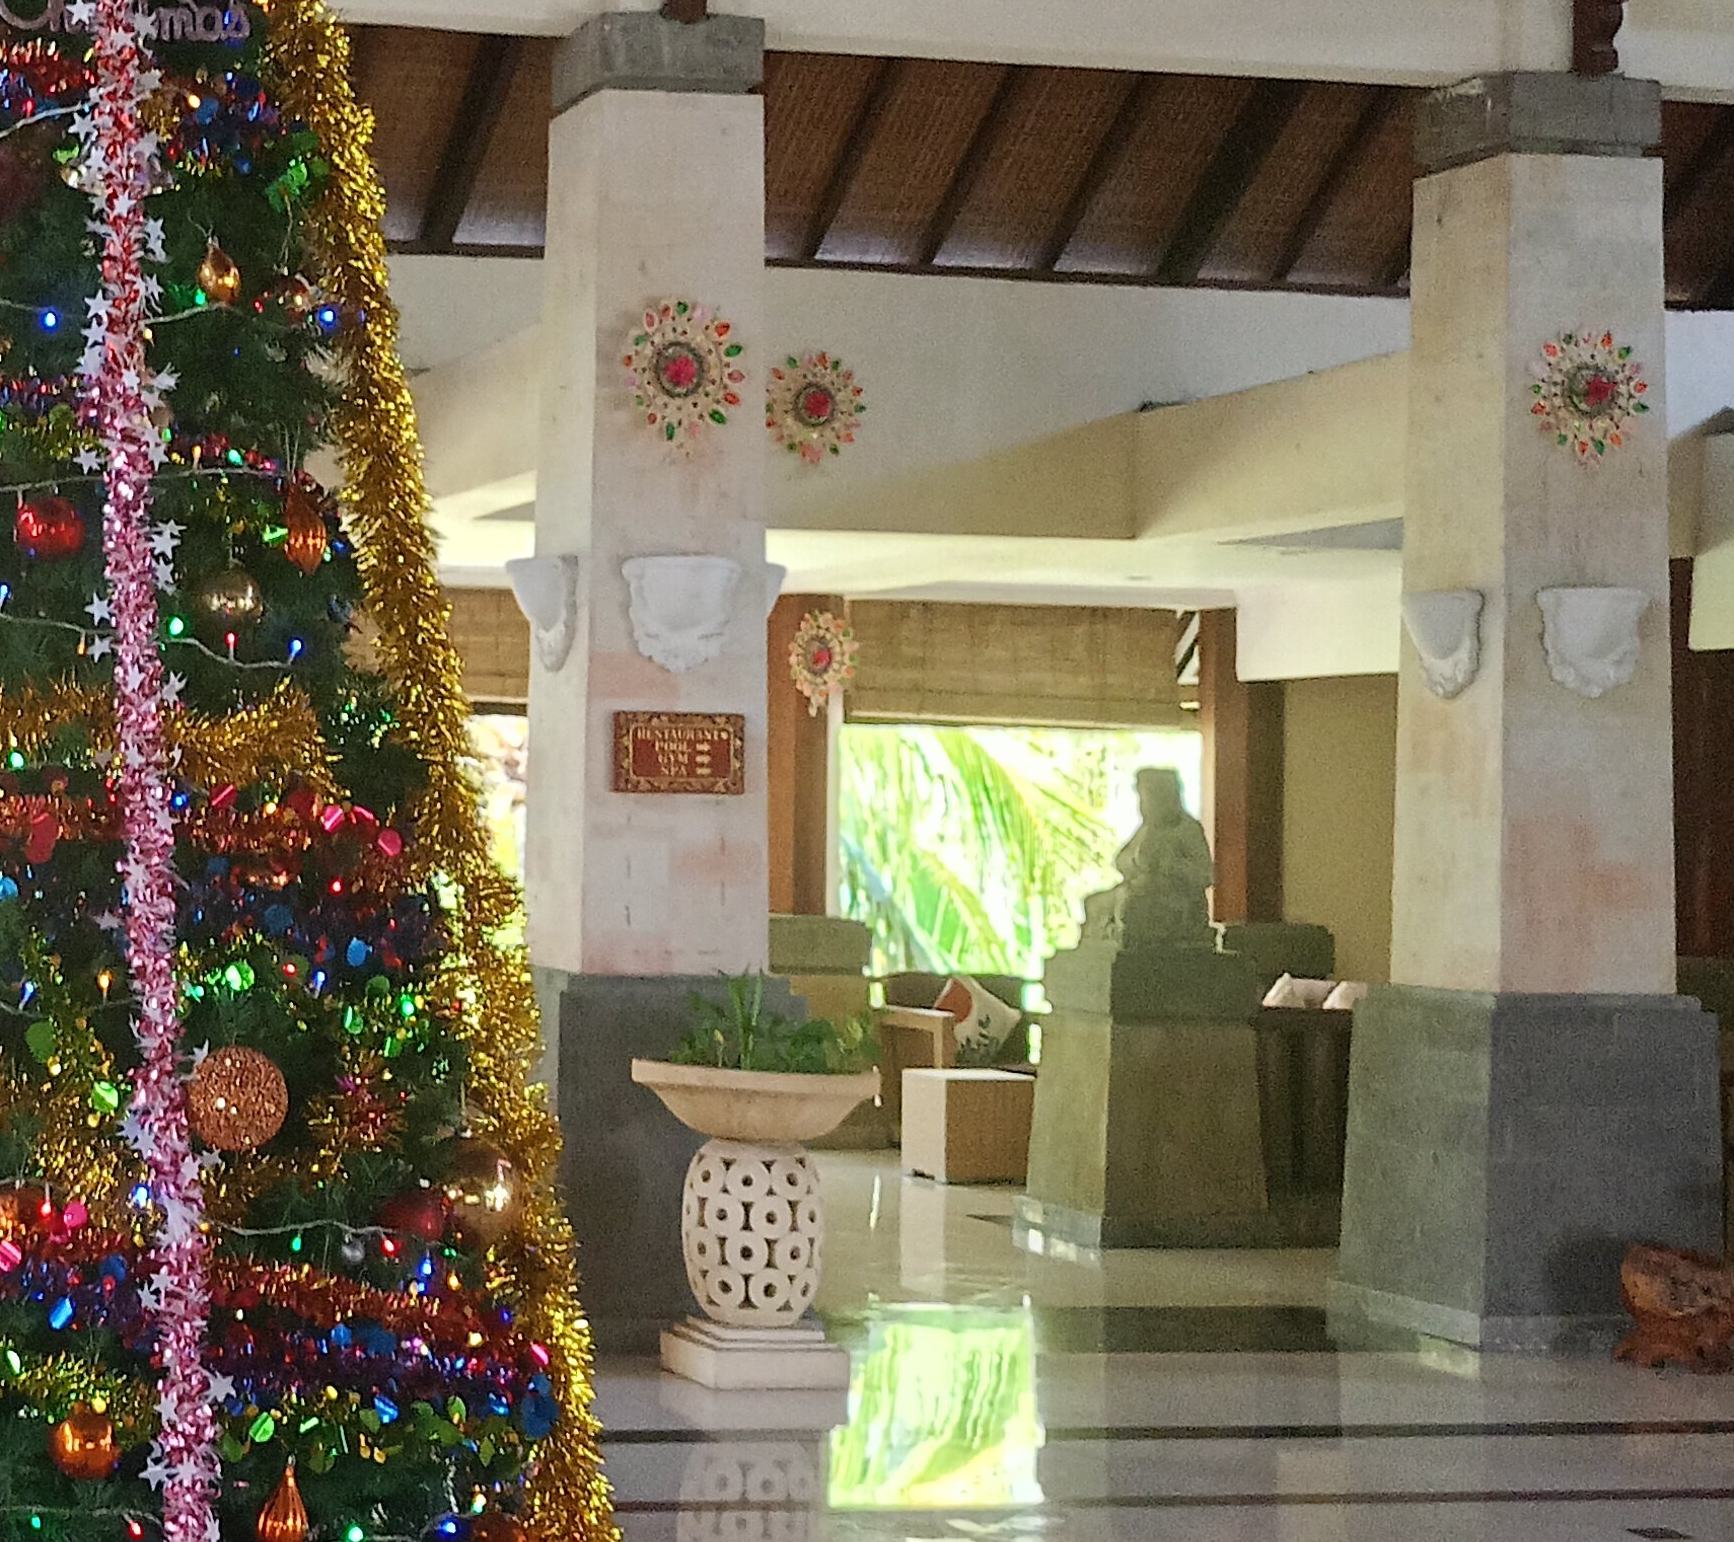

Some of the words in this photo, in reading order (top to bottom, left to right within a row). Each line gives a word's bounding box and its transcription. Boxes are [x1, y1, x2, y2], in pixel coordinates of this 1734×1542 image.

[637, 728, 719, 740] RESTAURANT
[654, 740, 691, 752] POOL
[657, 752, 689, 764] GYM
[660, 765, 688, 777] SPA
